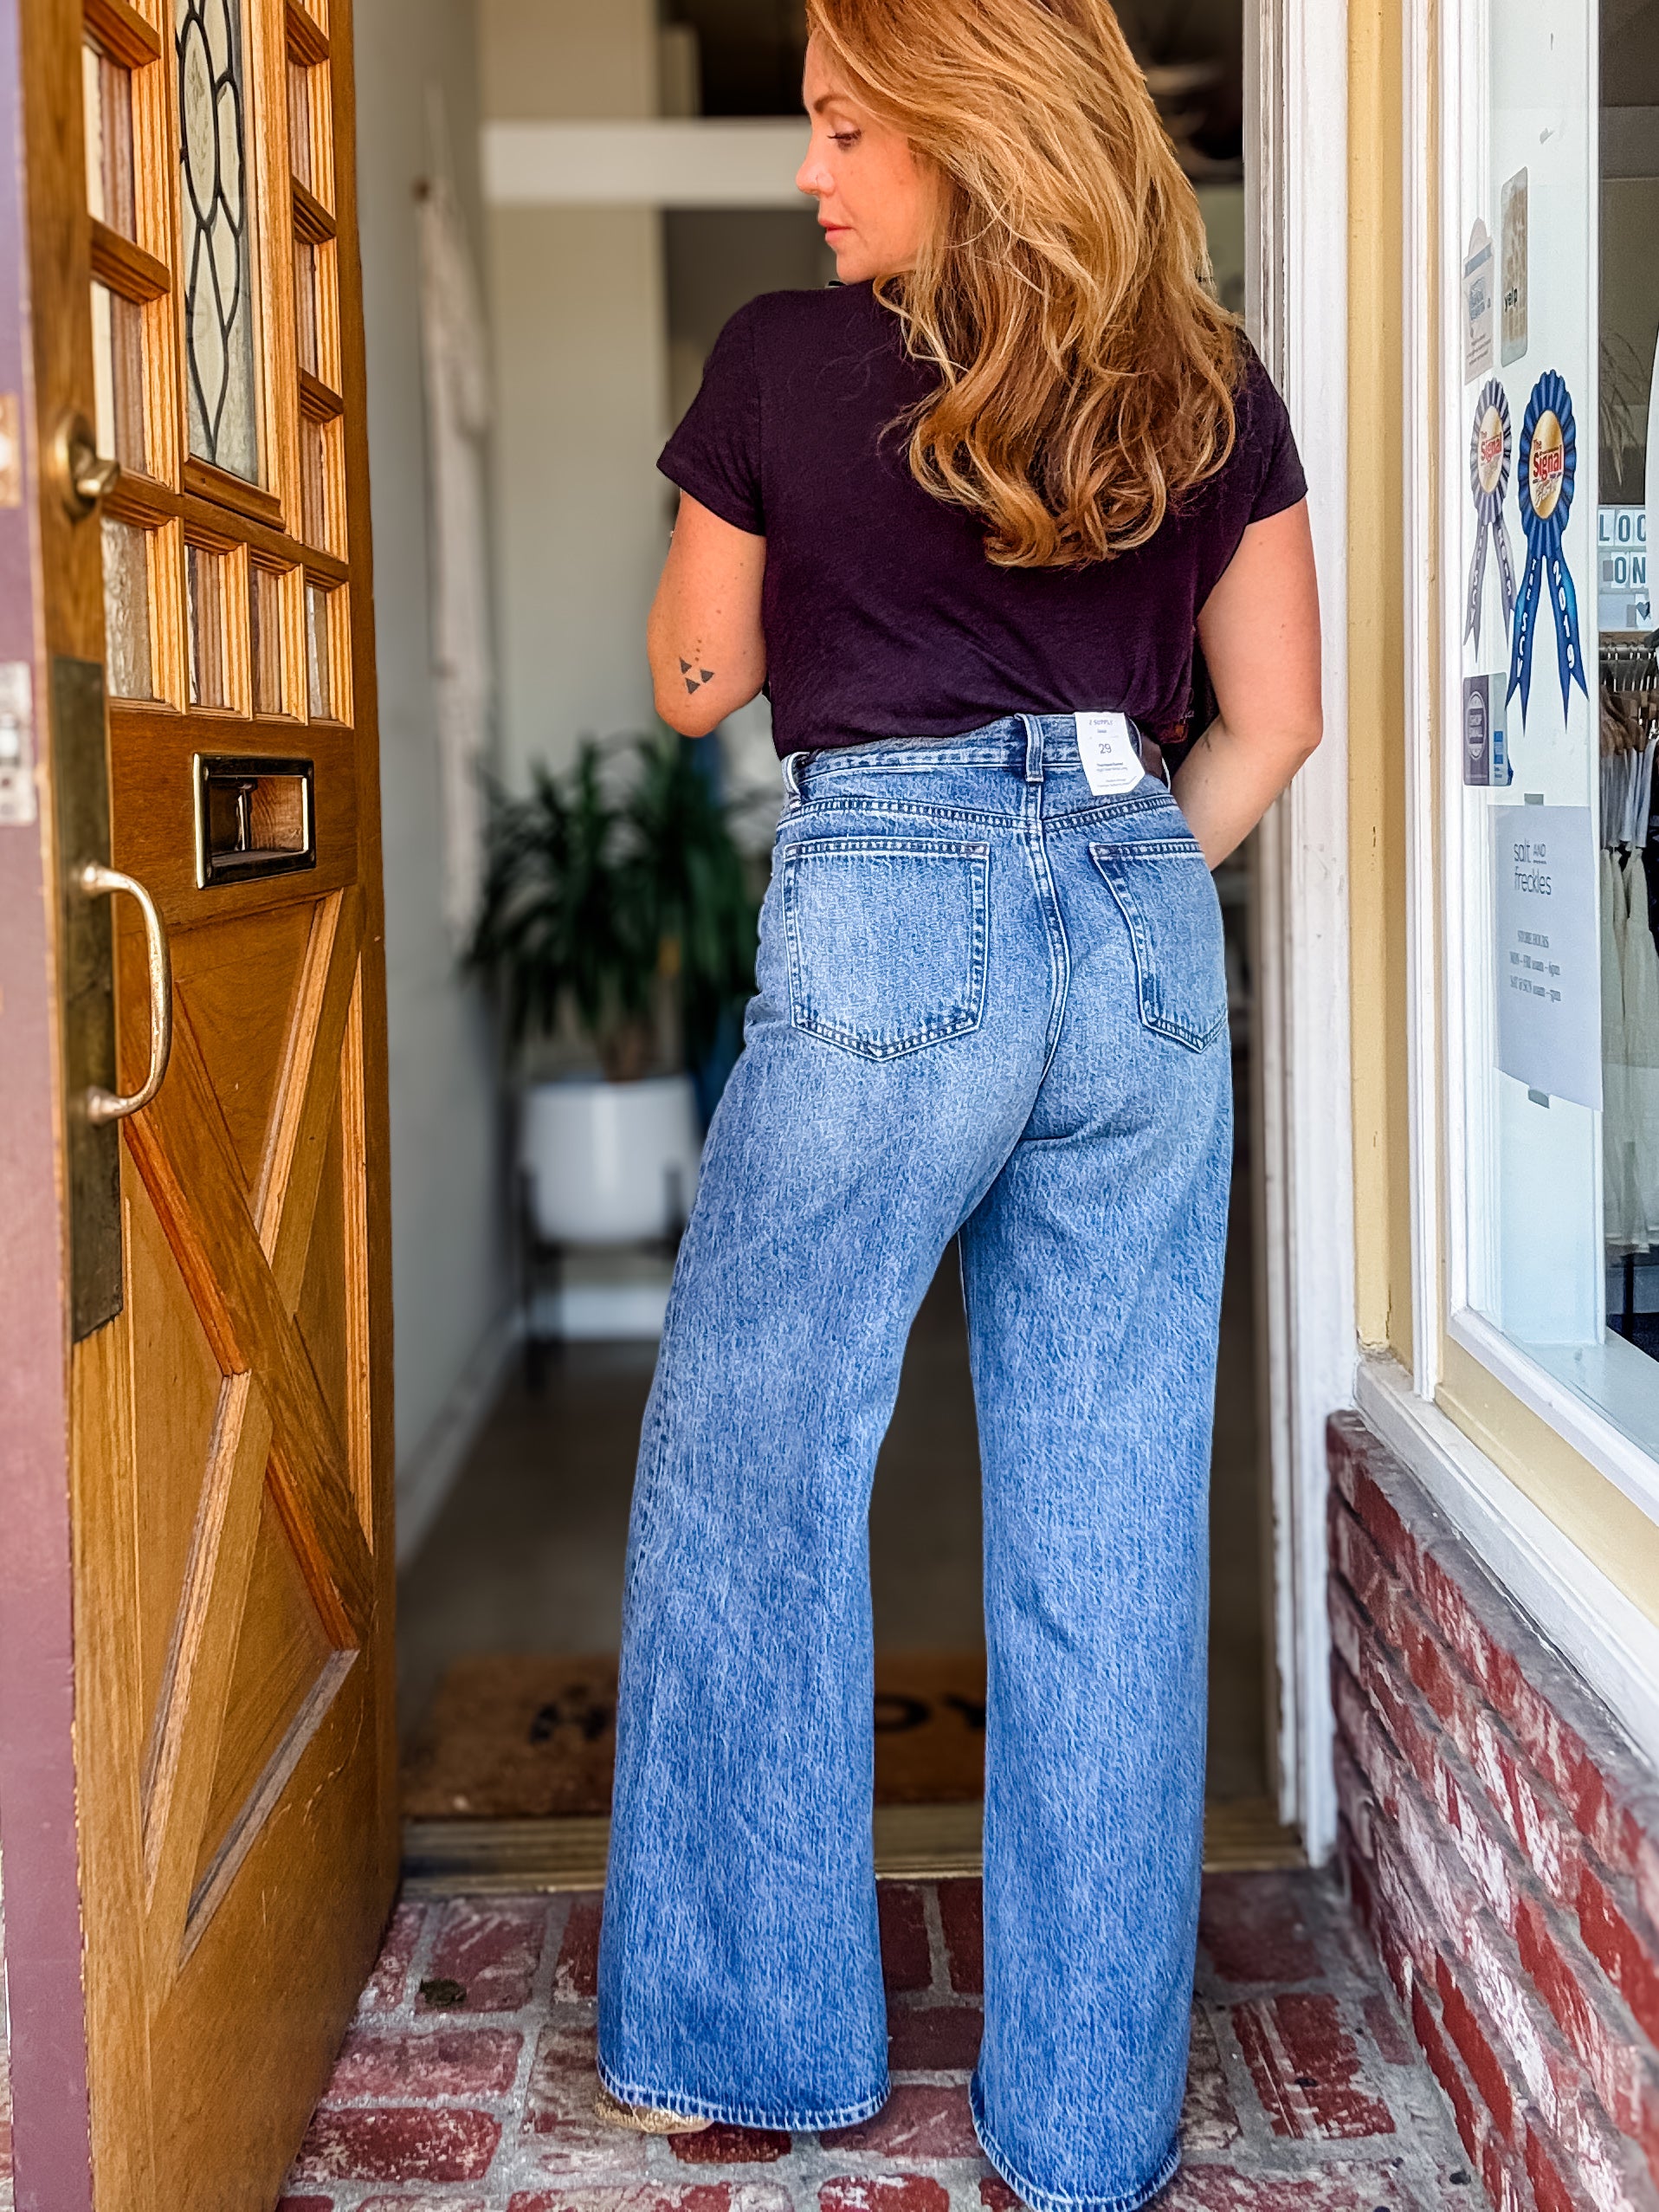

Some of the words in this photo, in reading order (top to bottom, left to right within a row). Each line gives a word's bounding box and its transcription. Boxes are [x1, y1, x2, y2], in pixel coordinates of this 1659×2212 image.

[1505, 287, 1517, 312] yelp
[1533, 445, 1562, 481] Signal
[1552, 559, 1575, 669] 2019
[1098, 743, 1112, 754] 29
[1514, 838, 1531, 863] salt
[1514, 866, 1552, 895] freckles
